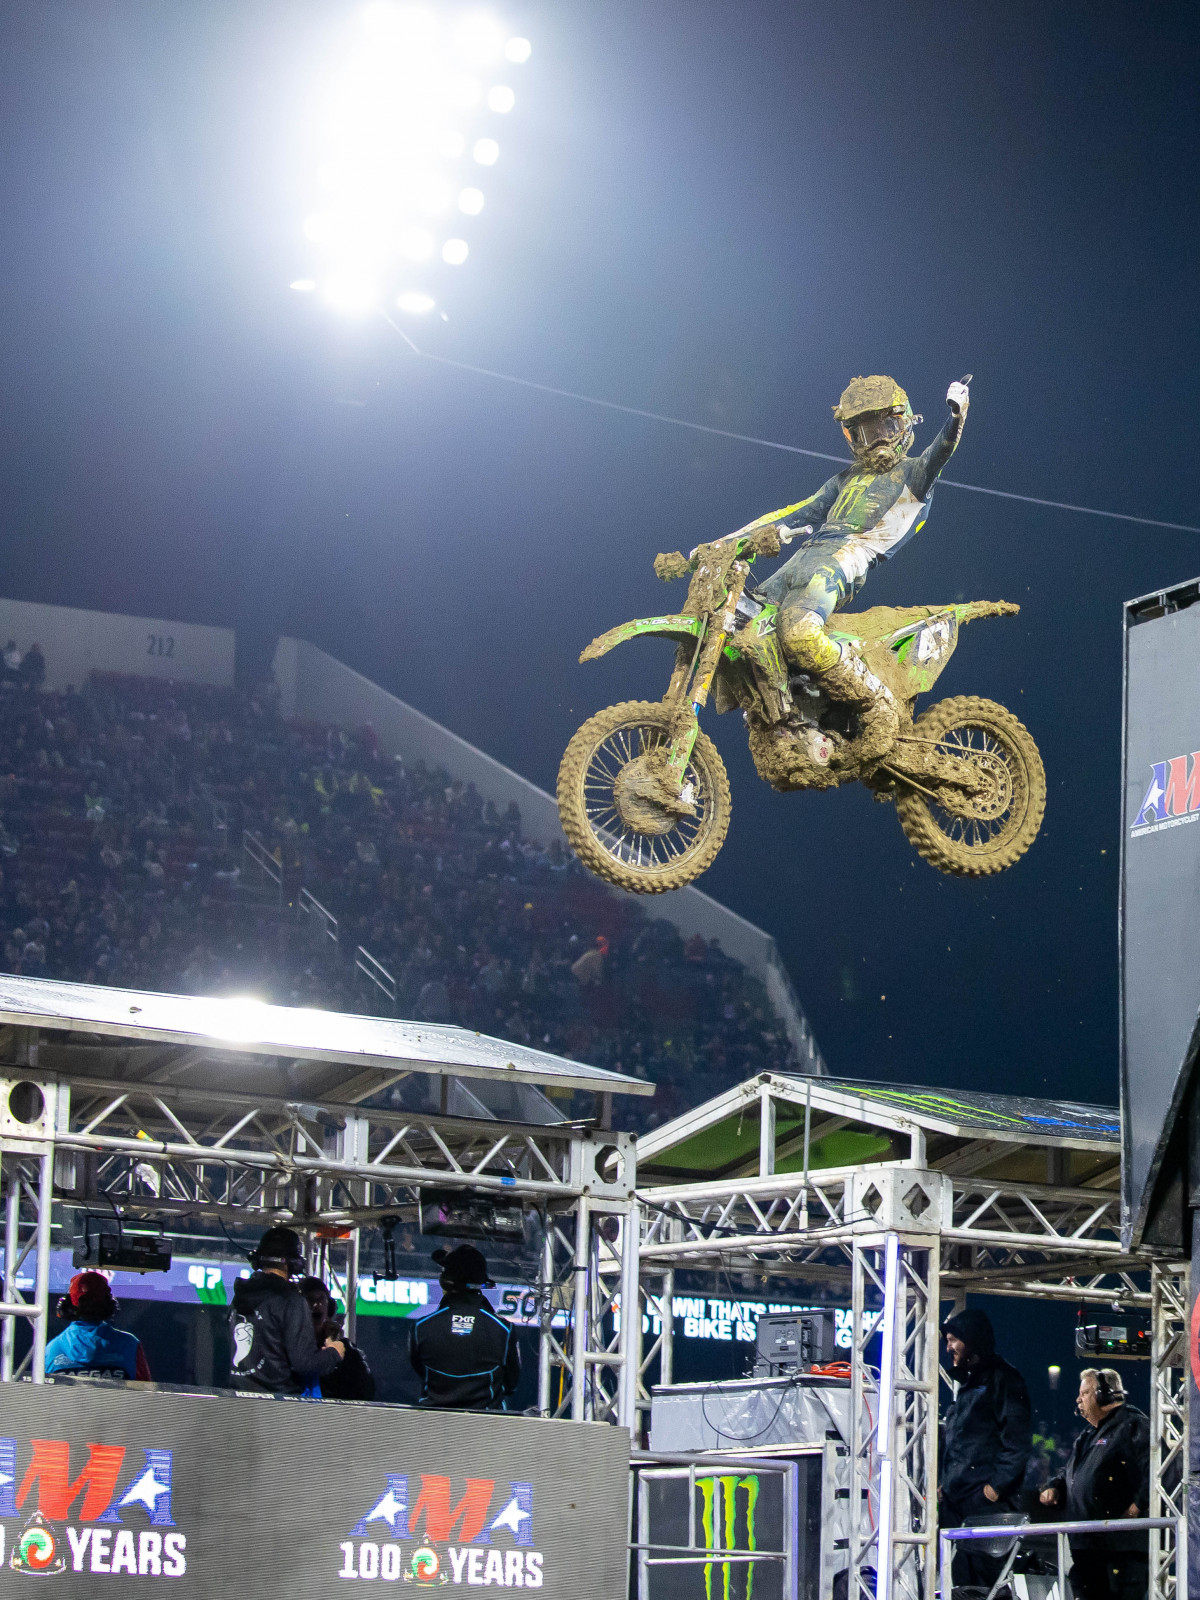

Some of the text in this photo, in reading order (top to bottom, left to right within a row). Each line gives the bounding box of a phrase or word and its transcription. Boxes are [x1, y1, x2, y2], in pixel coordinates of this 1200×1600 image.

[147, 634, 174, 657] 212
[1130, 825, 1159, 838] AMERICAN
[188, 1265, 222, 1290] 47
[452, 1314, 476, 1324] FXR
[707, 1299, 767, 1322] THAT'S
[683, 1317, 733, 1341] BIKE
[735, 1321, 757, 1342] IS
[347, 1473, 535, 1547] AMA
[67, 1526, 187, 1577] YEARS
[339, 1541, 544, 1588] 100 YEARS
